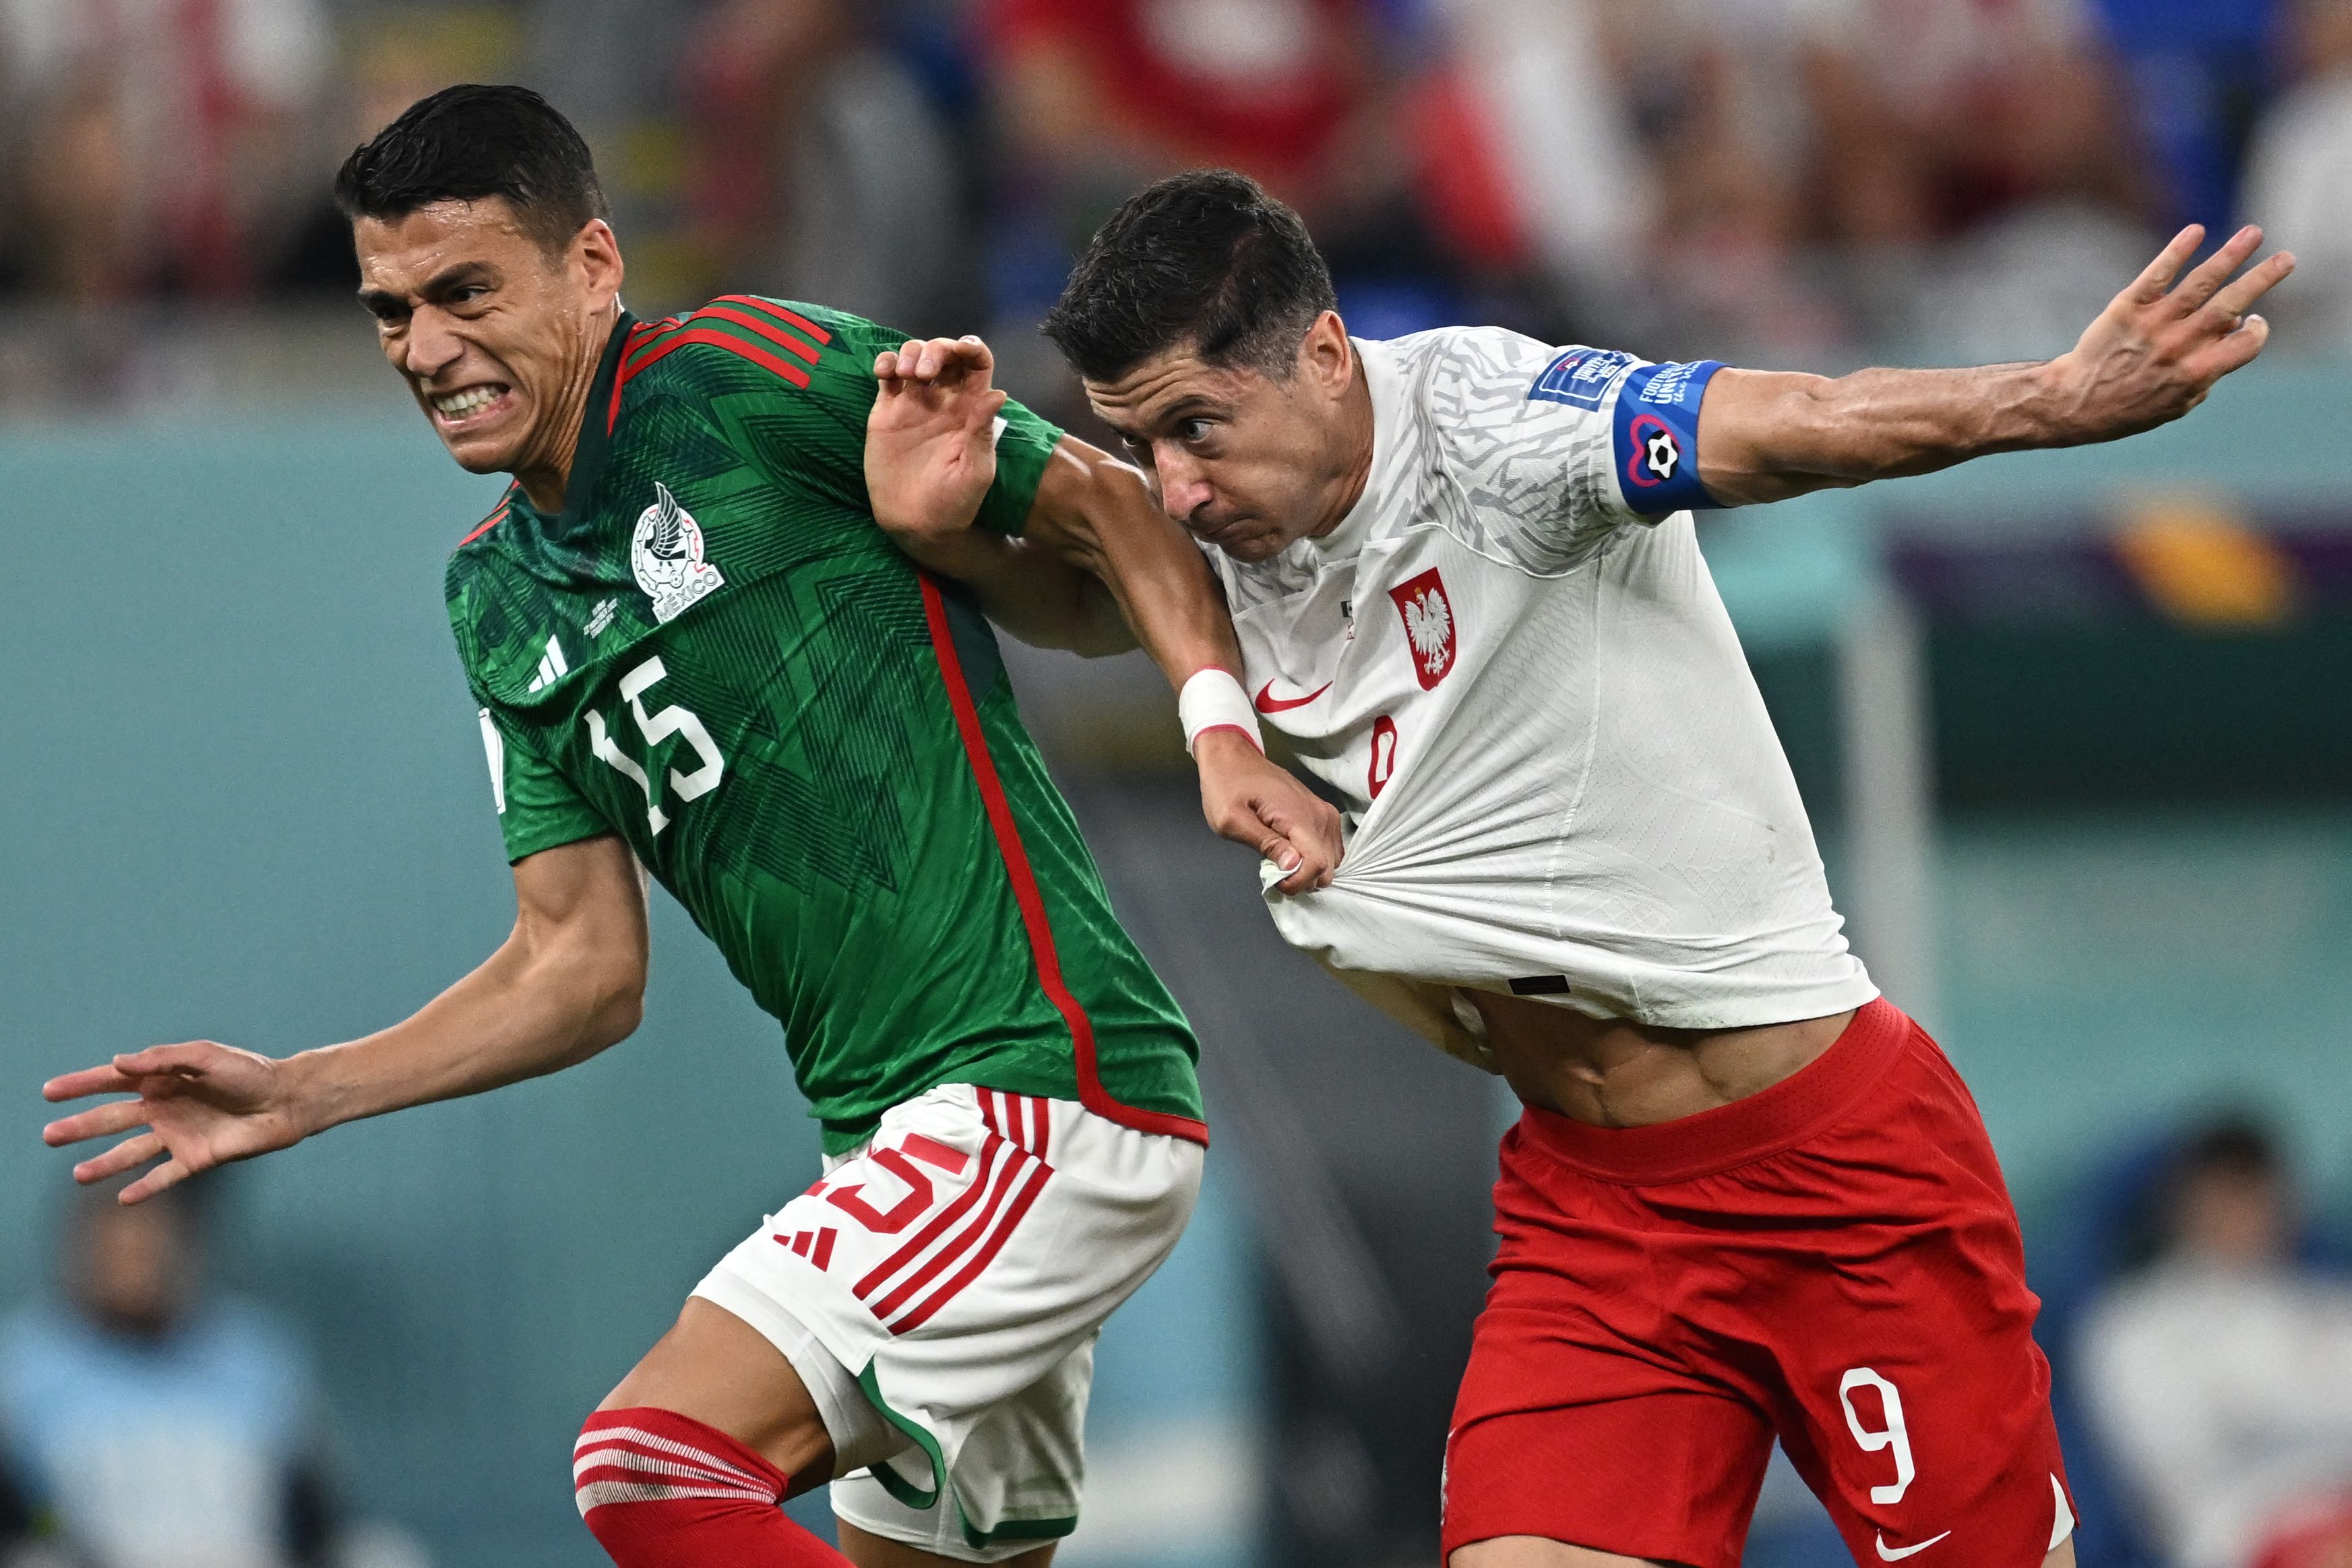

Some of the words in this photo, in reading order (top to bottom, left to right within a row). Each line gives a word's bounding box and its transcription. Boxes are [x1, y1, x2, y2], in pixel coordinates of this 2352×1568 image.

[656, 571, 718, 623] MÉXICO
[584, 655, 724, 836] 15
[802, 1133, 969, 1234] 5
[1839, 1367, 1915, 1504] 9
